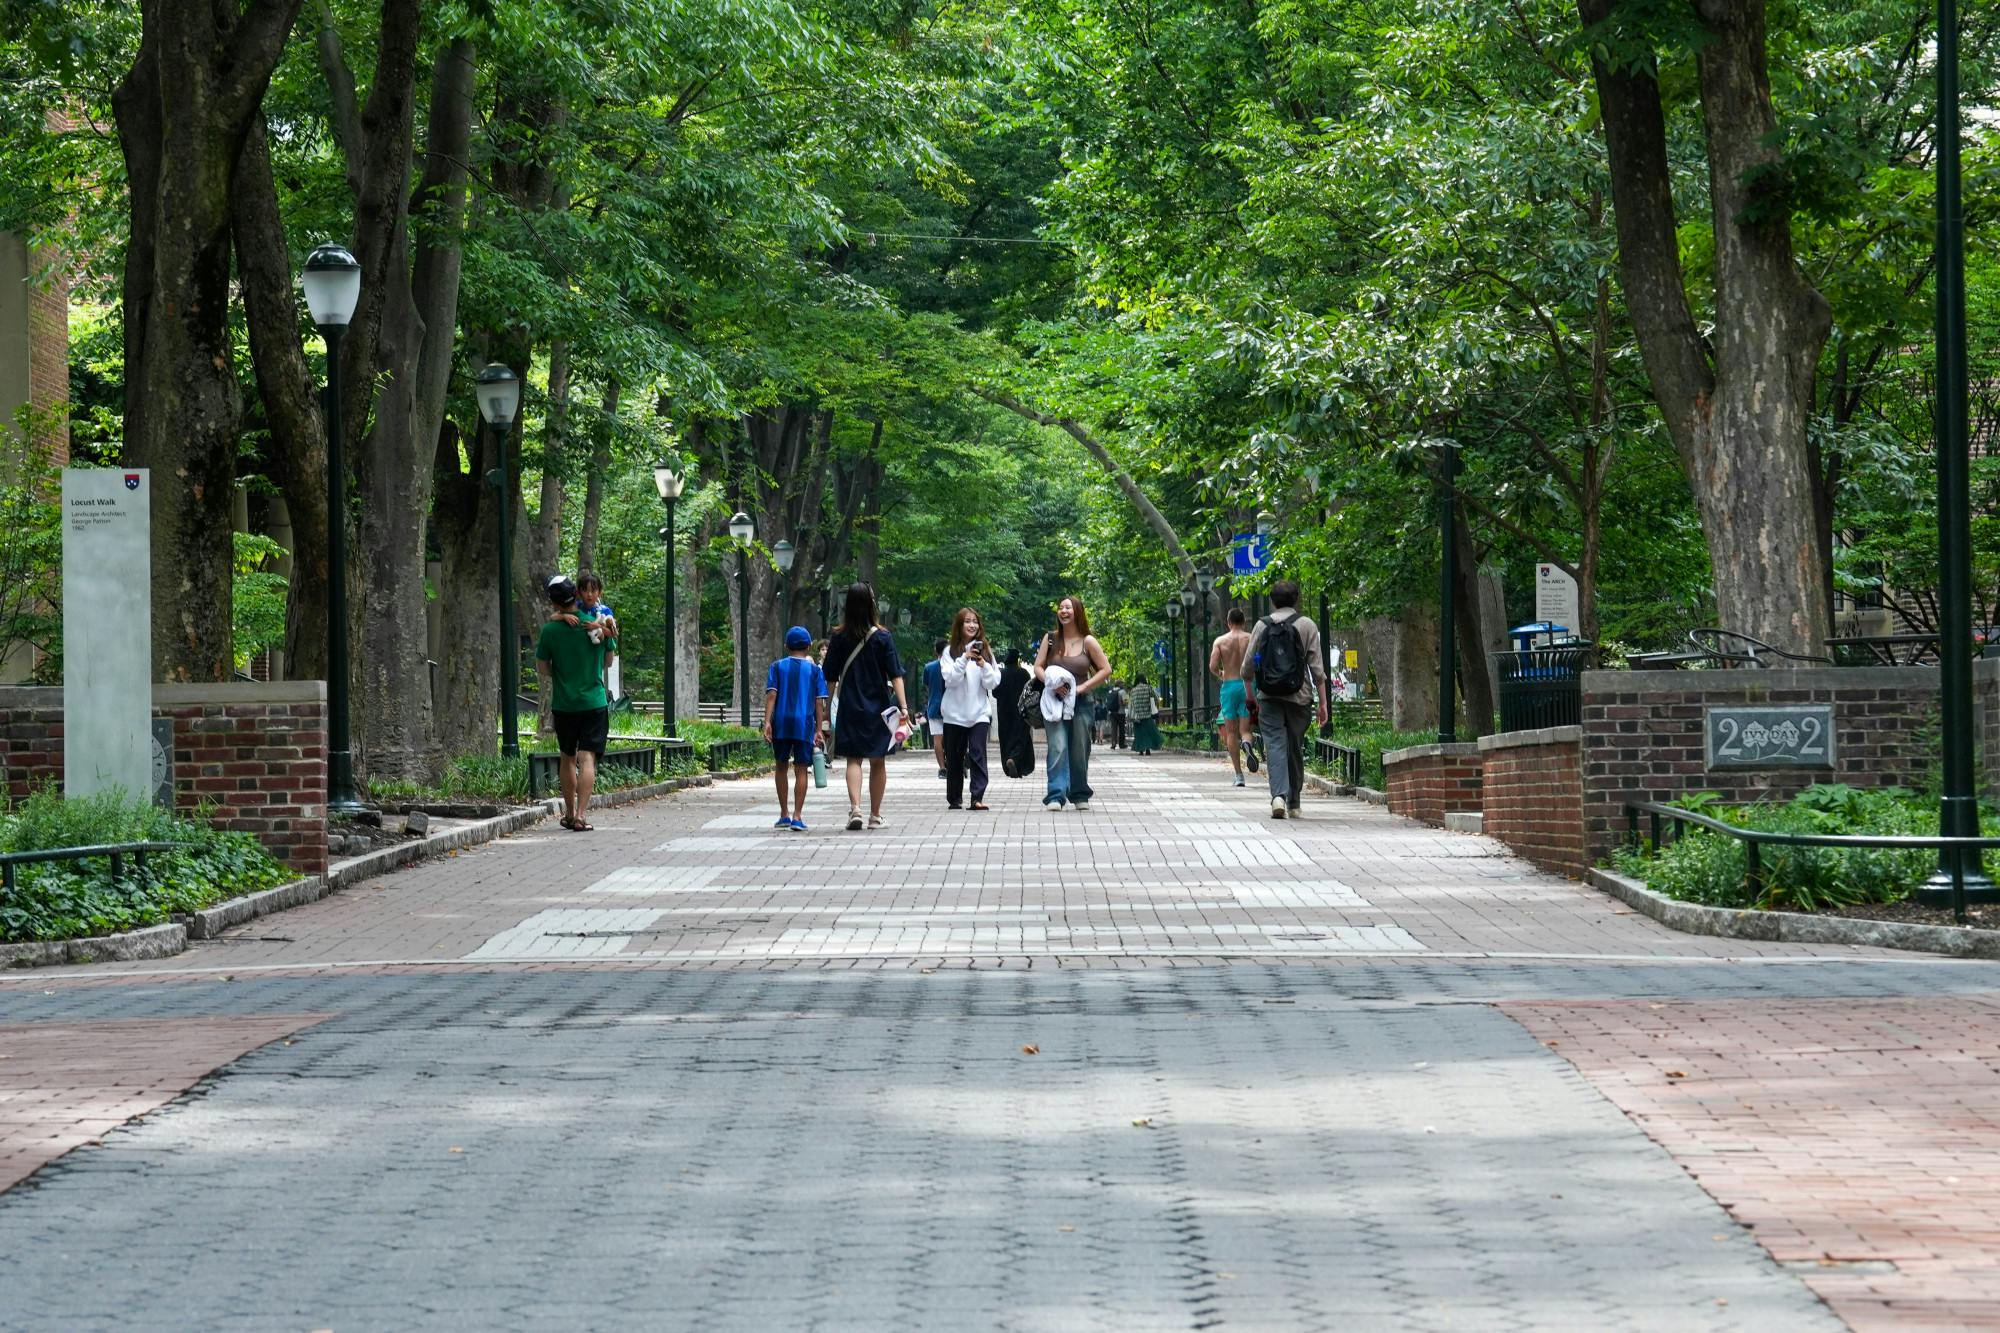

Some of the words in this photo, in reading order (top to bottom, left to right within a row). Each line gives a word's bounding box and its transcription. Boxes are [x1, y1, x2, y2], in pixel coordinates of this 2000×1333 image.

[97, 498, 115, 506] Walk
[1744, 730, 1766, 738] IVY
[1771, 730, 1797, 738] DAY
